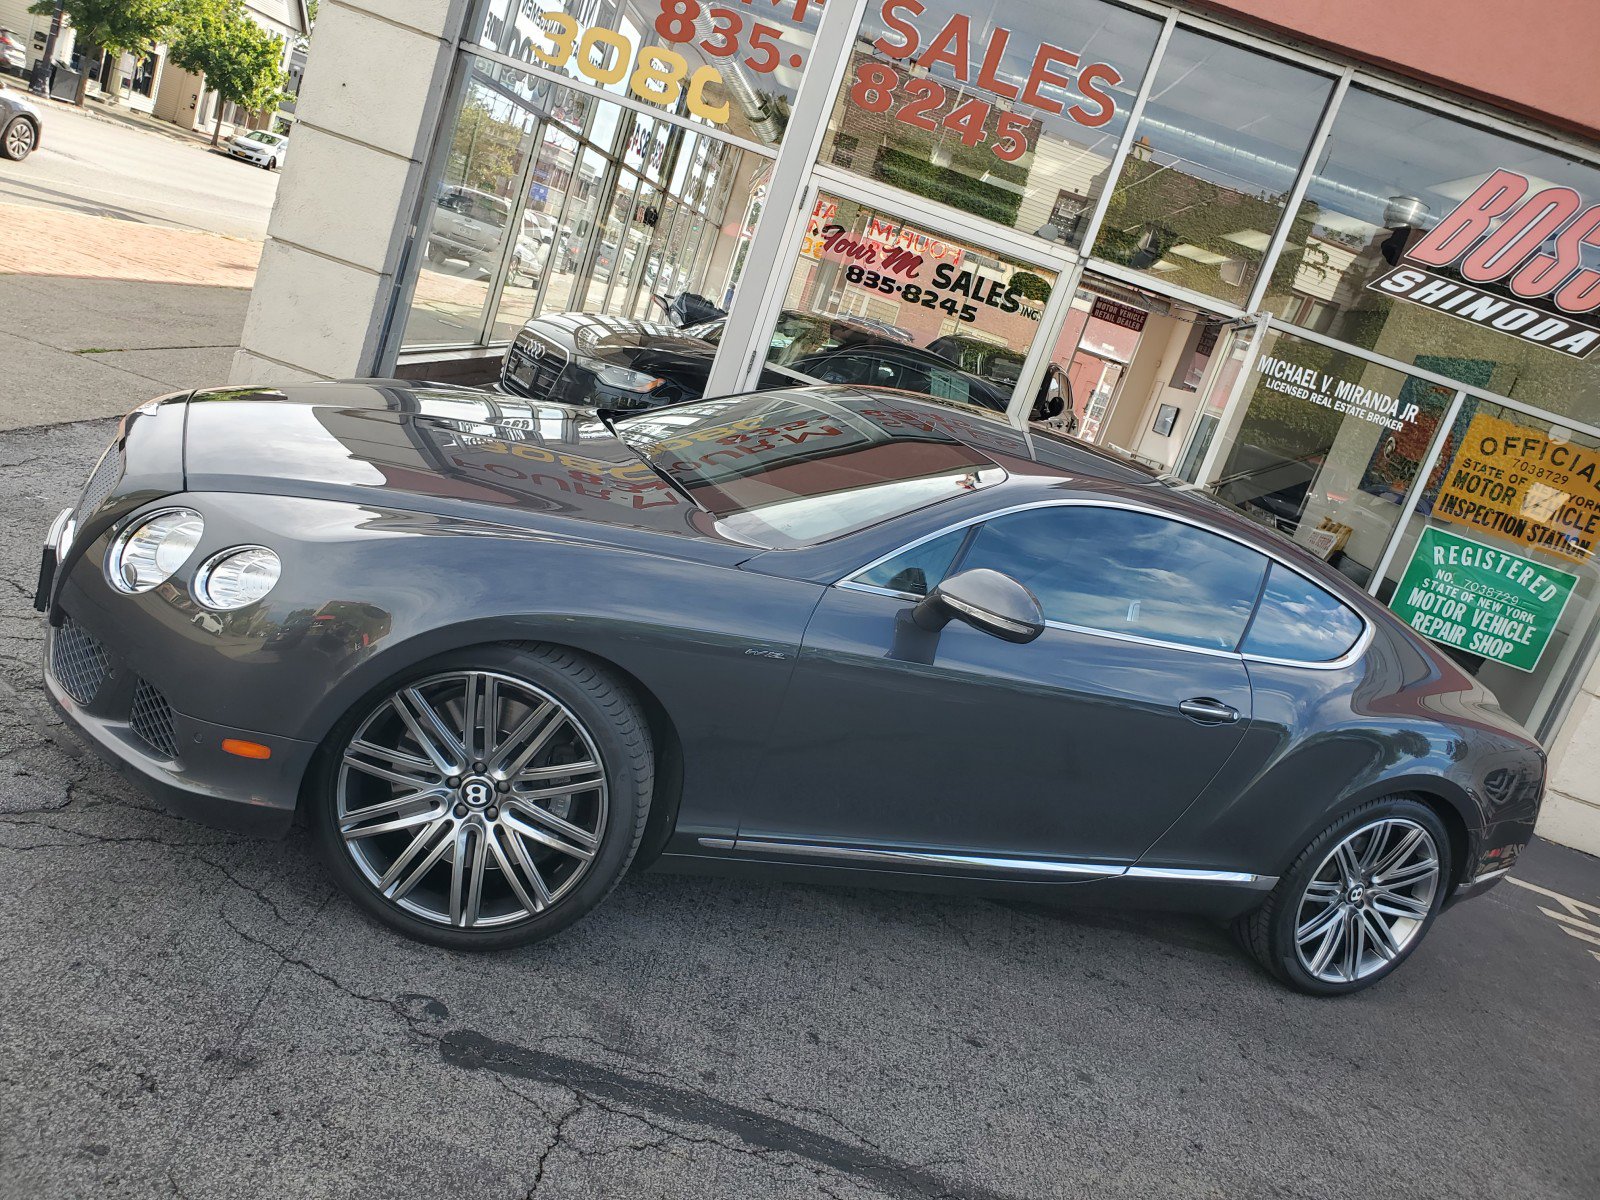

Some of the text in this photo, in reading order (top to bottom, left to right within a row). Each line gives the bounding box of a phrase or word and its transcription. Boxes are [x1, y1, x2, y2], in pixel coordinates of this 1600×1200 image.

[531, 11, 730, 124] 308C
[873, 0, 1124, 128] SALES
[850, 62, 1033, 162] 8245
[821, 223, 877, 265] Four
[931, 262, 1024, 313] SALES
[1094, 309, 1141, 331] RETAIL DEALER
[1095, 300, 1118, 314] MOTOR
[1119, 308, 1145, 324] VEHICLE
[1380, 269, 1600, 354] SHINODA
[1256, 354, 1420, 425] MICHAEL V. MIRANDA JR.
[1265, 377, 1404, 433] LICENSED REAL ESTATE BROKER
[1451, 469, 1517, 506] MOTOR
[1462, 458, 1505, 480] STATE
[1508, 473, 1529, 486] OF
[1512, 458, 1570, 485] 7038729
[1438, 492, 1591, 557] INSPECTION STATION
[1421, 577, 1537, 624] STATE OF NEW YORK
[1433, 545, 1557, 602] REGISTERED
[1463, 578, 1519, 605] 7038729
[1406, 587, 1537, 646] MOTOR VEHICLE
[1410, 611, 1514, 660] REPAIR SHOP
